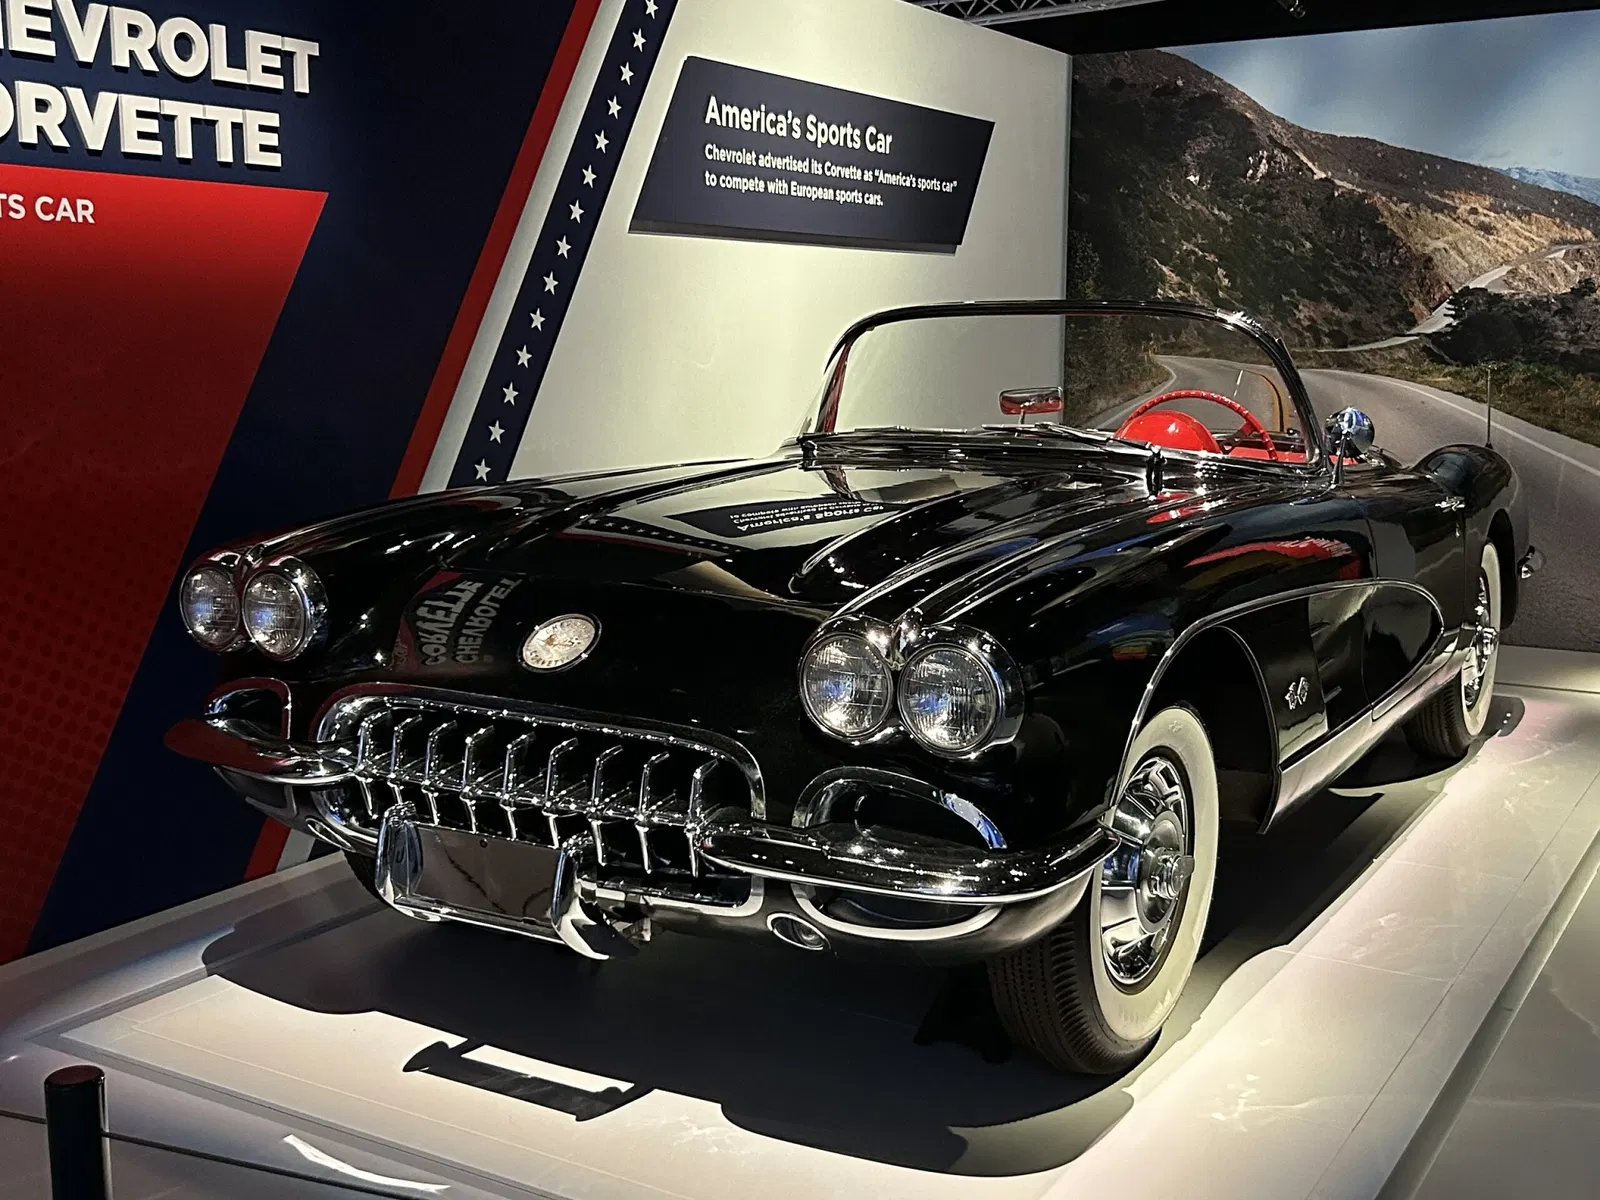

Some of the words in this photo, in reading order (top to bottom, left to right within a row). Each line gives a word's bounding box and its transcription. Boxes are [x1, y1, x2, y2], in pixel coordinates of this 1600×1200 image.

[0, 0, 319, 94] EVROLET
[0, 80, 282, 167] RVETTE
[704, 95, 801, 139] America's
[805, 113, 861, 149] Sports
[865, 126, 892, 154] Car
[704, 143, 757, 167] Chevrolet
[758, 151, 809, 174] advertised
[811, 158, 823, 175] its
[824, 161, 862, 180] Corvette
[863, 169, 873, 182] as
[917, 177, 941, 192] sports
[704, 170, 718, 187] to
[719, 173, 765, 194] compete
[767, 178, 789, 196] with
[790, 181, 835, 202] European
[835, 189, 863, 204] sports
[864, 193, 884, 206] cars.
[34, 195, 96, 224] CAR
